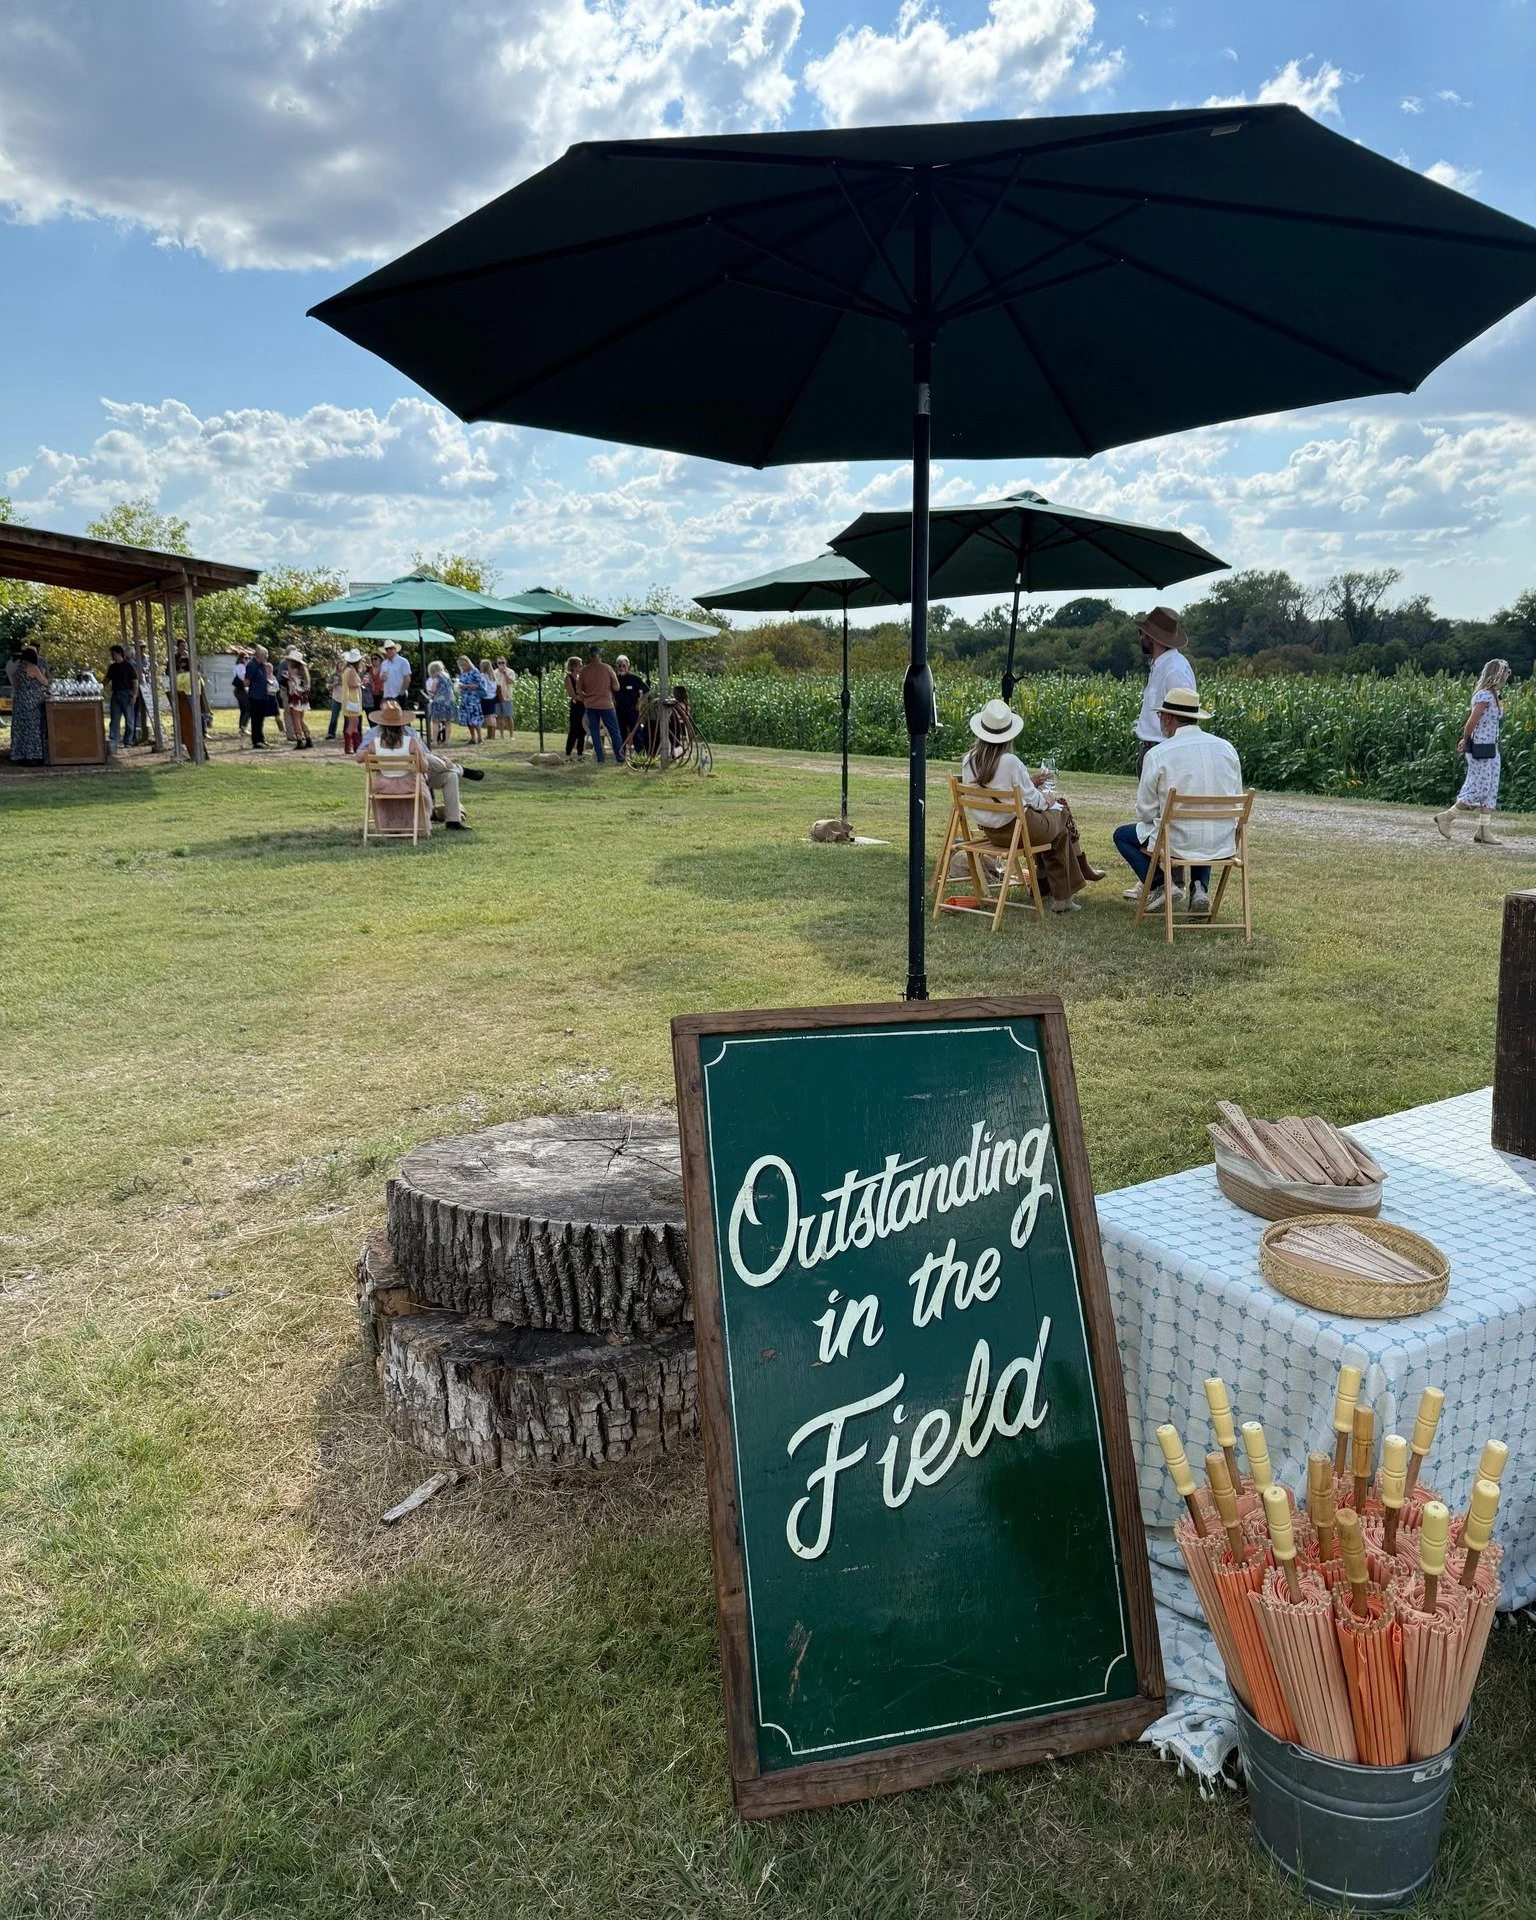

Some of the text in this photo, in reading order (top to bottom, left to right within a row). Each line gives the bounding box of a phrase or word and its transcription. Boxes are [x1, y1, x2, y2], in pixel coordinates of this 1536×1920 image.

[729, 1120, 1053, 1287] Outstanding
[812, 1238, 1001, 1363] in the
[787, 1316, 1050, 1559] Field
